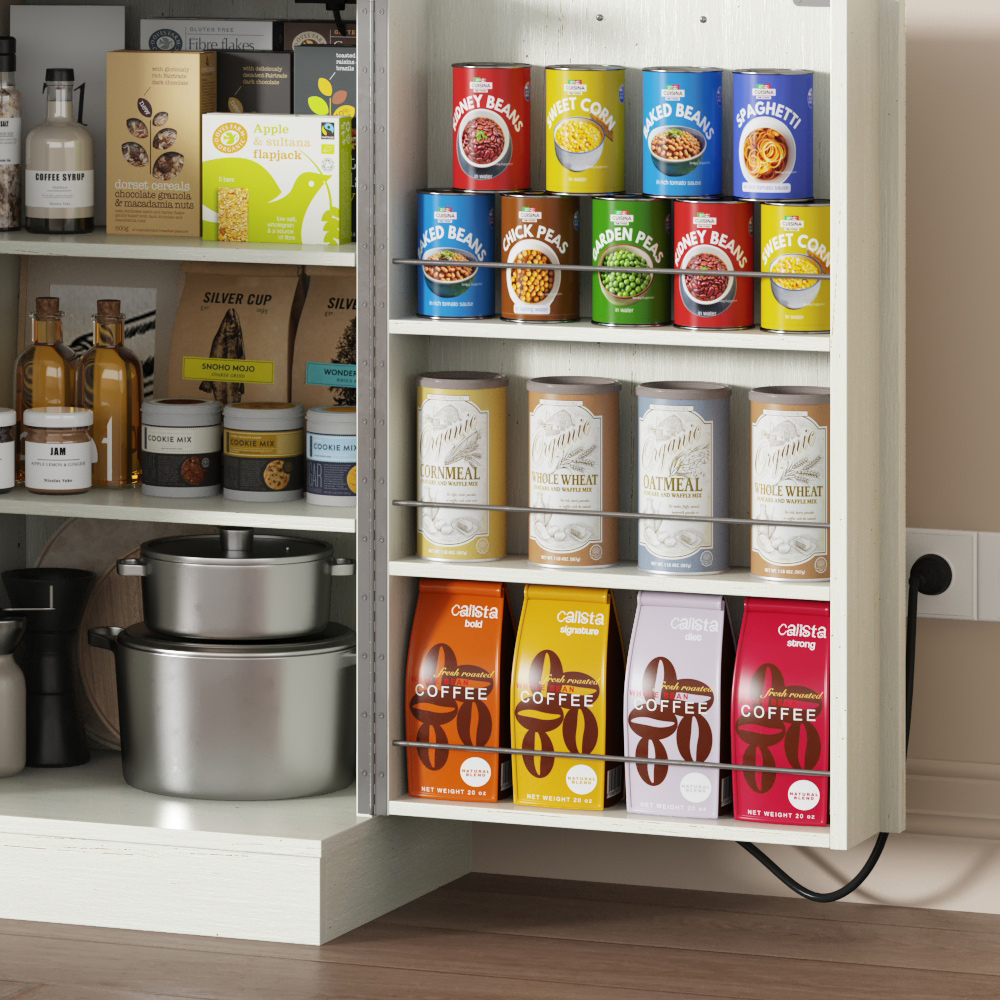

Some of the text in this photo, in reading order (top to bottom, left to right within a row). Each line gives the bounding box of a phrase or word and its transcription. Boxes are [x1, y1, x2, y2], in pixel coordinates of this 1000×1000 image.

[189, 37, 255, 51] Fibre flakes
[139, 100, 151, 115] new
[486, 95, 523, 132] BEANS
[547, 97, 616, 131] SWEET CORN
[675, 103, 714, 140] BEANS
[736, 101, 801, 129] SPAGHETTI
[253, 124, 289, 136] Apple
[253, 137, 311, 147] & sultana
[253, 149, 302, 162] flapjack
[35, 173, 85, 181] COFFEE SYRUP
[114, 179, 190, 191] dorset cereals
[114, 190, 191, 200] chocolate granola
[114, 199, 122, 207] &
[124, 200, 173, 208] macadamia
[448, 225, 486, 262] BEANS
[502, 224, 568, 255] CHICK PEAS
[592, 227, 664, 264] GARDEN PEAS
[674, 230, 748, 269] KIDNEY BEANS
[762, 233, 793, 266] SWEET
[203, 291, 272, 306] SILVER CUP
[327, 297, 357, 310] SILVE
[201, 363, 255, 373] SNOHO MOJO
[147, 434, 175, 443] COOKIE
[230, 438, 275, 447] COOKIE MIX
[420, 413, 477, 458] Organic
[532, 419, 592, 466] Organic
[50, 447, 66, 456] JAM
[313, 442, 341, 451] COOKIE
[642, 424, 701, 470] Organic
[755, 429, 817, 475] Organic
[420, 463, 480, 480] CORNMEAL
[532, 471, 598, 486] WHOLE WHEAT
[643, 474, 702, 492] OATMEAL
[754, 482, 824, 497] WHOLE WHEAT
[451, 604, 499, 619] Calista
[556, 610, 605, 626] Calista
[464, 619, 483, 628] bold
[560, 625, 600, 636] signature
[670, 616, 719, 633] Calista
[777, 623, 827, 639] Calista
[787, 639, 816, 651] strong
[433, 667, 495, 679] fresh roasted
[539, 673, 600, 686] fresh roasted
[443, 677, 469, 686] BEAN
[549, 684, 575, 693] BEAN
[653, 680, 714, 693] fresh roasted
[415, 683, 488, 701] COFFEE
[519, 690, 594, 707] COFFEE
[663, 691, 689, 700] BEAN
[760, 687, 824, 700] fresh roasted
[633, 698, 708, 715] COFFEE
[740, 704, 817, 722] COFFEE
[437, 787, 465, 795] WEIGHT
[542, 795, 571, 803] WEIGHT
[763, 810, 793, 819] WEIGHT
